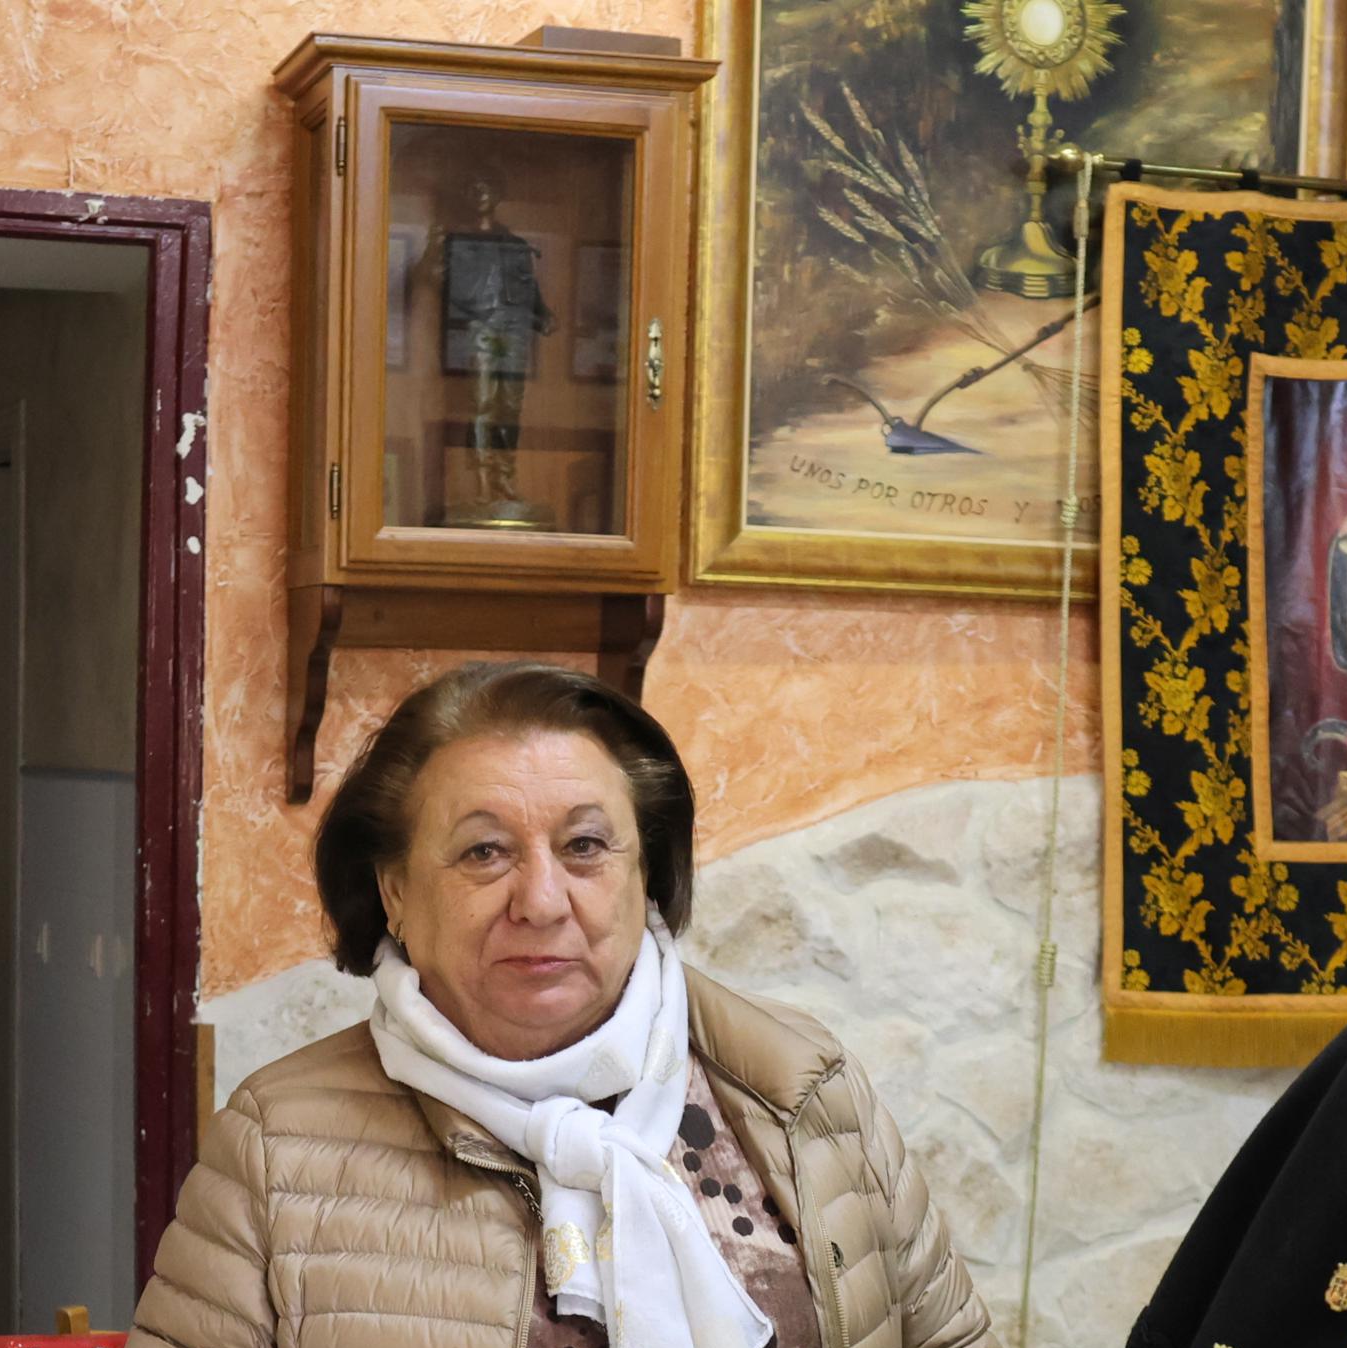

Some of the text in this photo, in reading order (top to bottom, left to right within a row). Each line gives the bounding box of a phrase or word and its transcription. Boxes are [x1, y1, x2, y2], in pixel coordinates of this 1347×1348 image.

[789, 455, 846, 490] UNOS
[852, 476, 899, 508] POR
[909, 489, 989, 516] OTROS
[1014, 500, 1031, 524] Y
